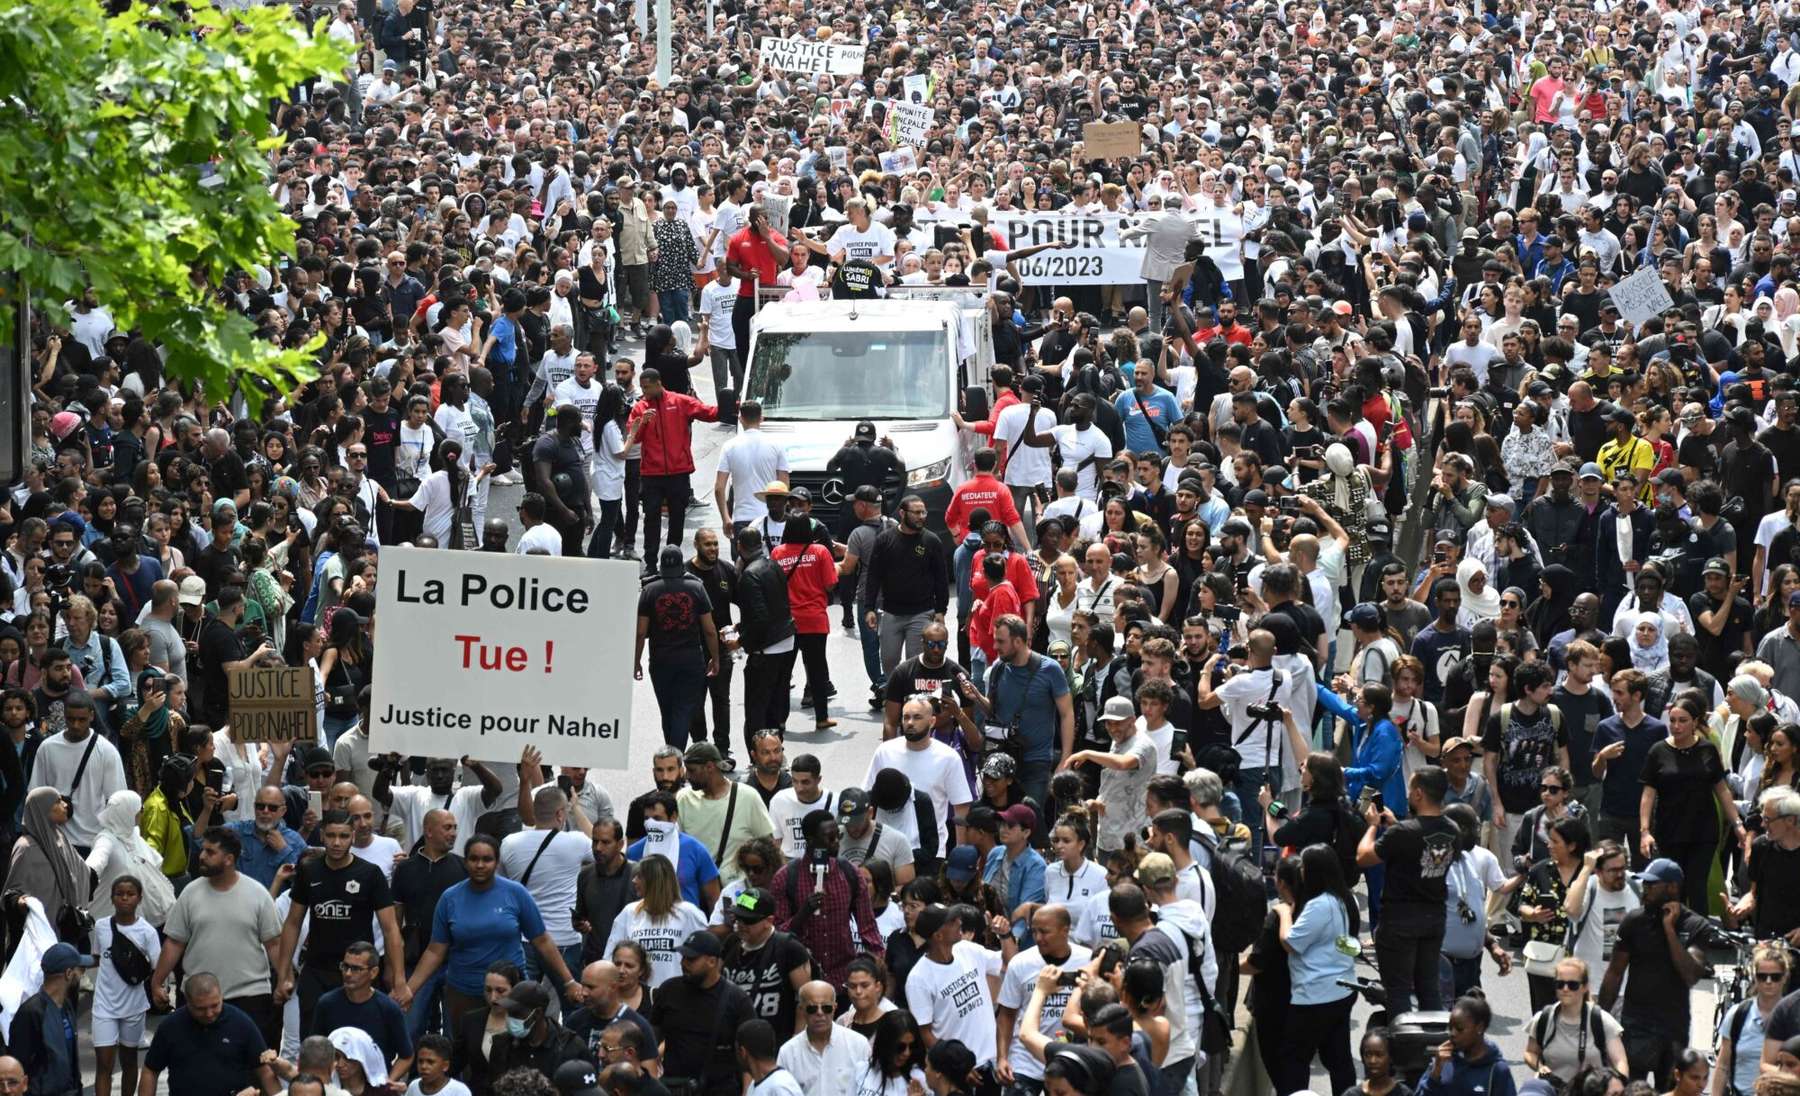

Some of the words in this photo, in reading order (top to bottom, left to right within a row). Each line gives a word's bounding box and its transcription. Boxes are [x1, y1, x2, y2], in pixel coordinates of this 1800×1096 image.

[770, 52, 835, 73] NAHEL
[1008, 219, 1105, 250] POUR
[1119, 218, 1233, 248] NEL
[846, 272, 870, 284] SABRI
[1019, 256, 1104, 278] 06/2023
[777, 554, 817, 566] MEDIAEUR
[396, 569, 445, 605] La
[460, 573, 590, 614] Police
[454, 634, 529, 672] Tue
[230, 669, 301, 699] JUSTICE
[380, 703, 472, 730] Justice
[480, 714, 540, 736] pour
[548, 713, 620, 740] Nahel
[632, 928, 661, 938] JUSTICE
[641, 938, 672, 950] NAHEL
[940, 976, 967, 1000] JUSTICE
[1046, 994, 1069, 1006] AHE
